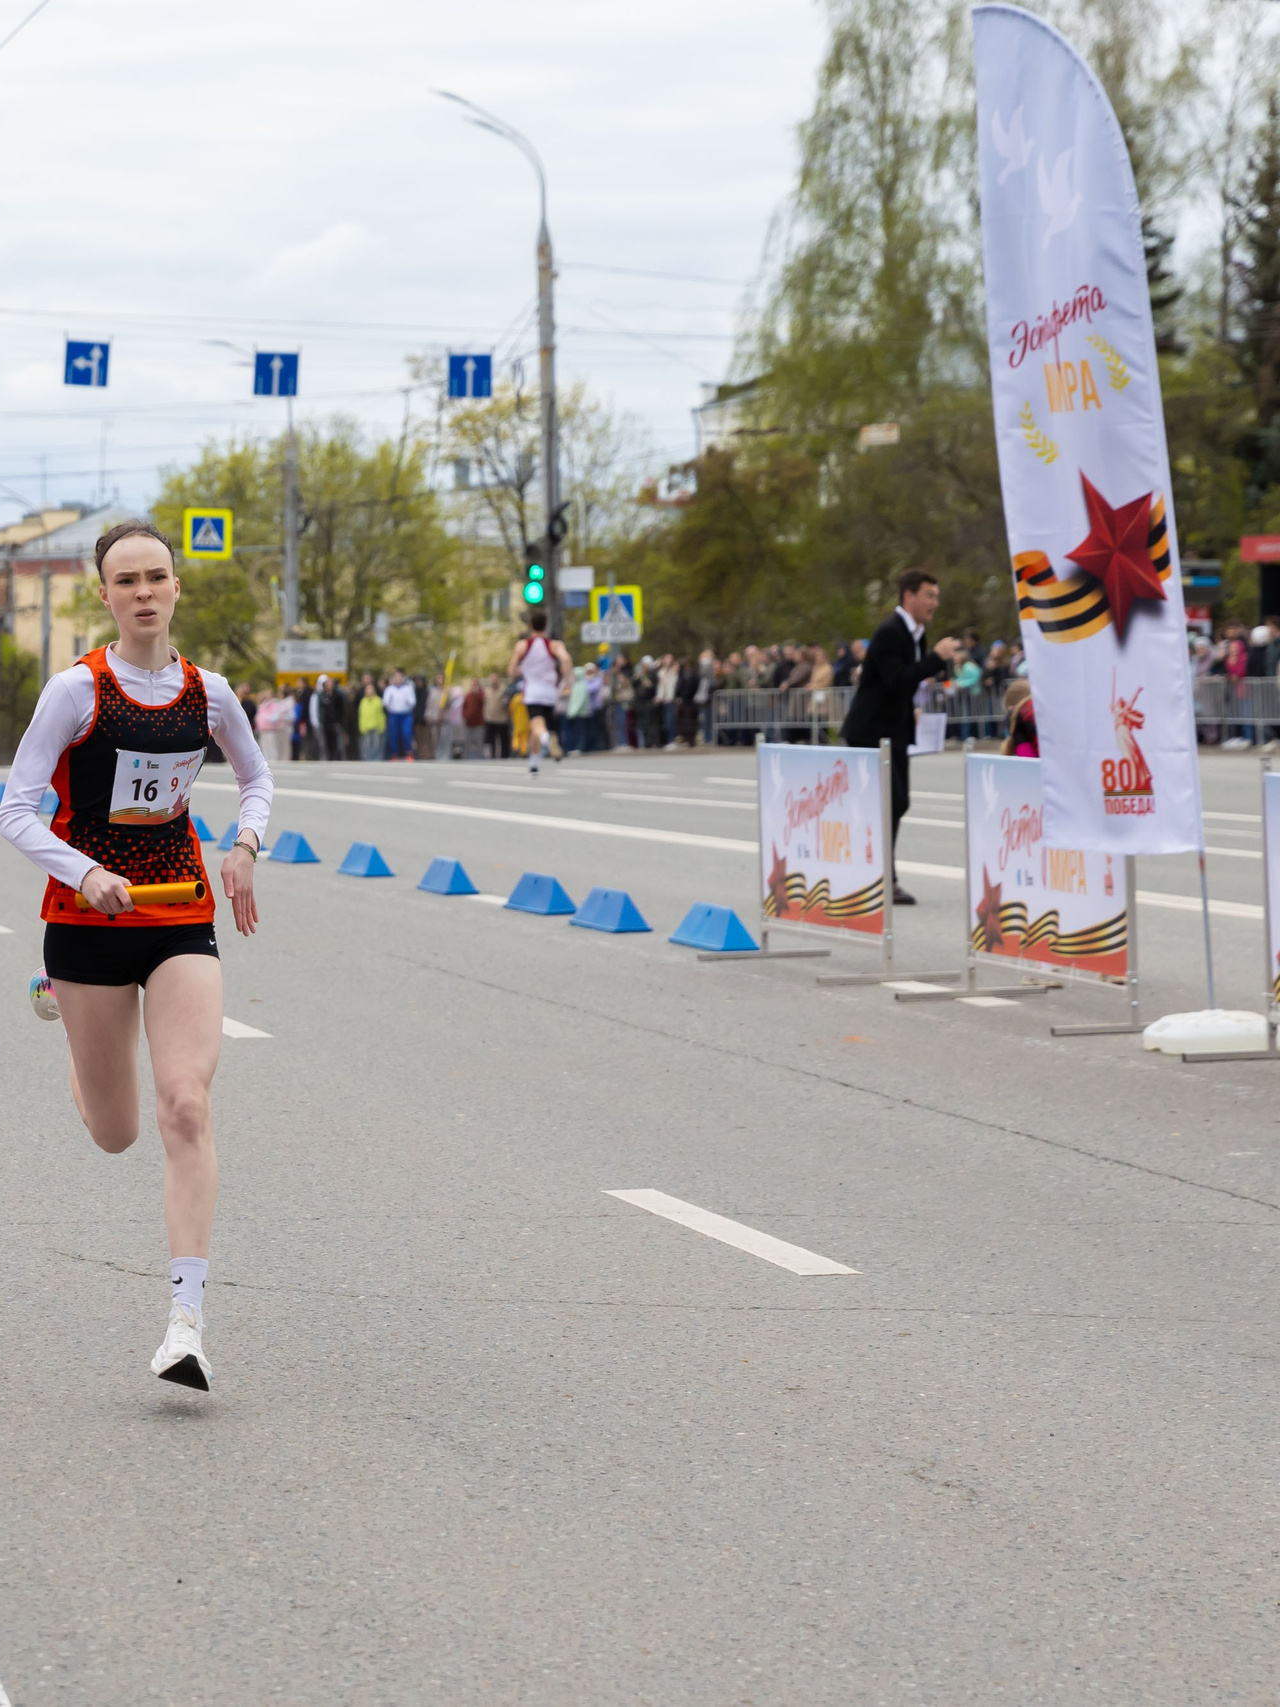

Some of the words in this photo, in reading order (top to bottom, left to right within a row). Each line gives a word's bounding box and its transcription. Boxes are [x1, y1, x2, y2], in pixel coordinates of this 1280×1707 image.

[170, 777, 179, 793] 9
[1101, 758, 1131, 791] 80
[131, 778, 159, 802] 16
